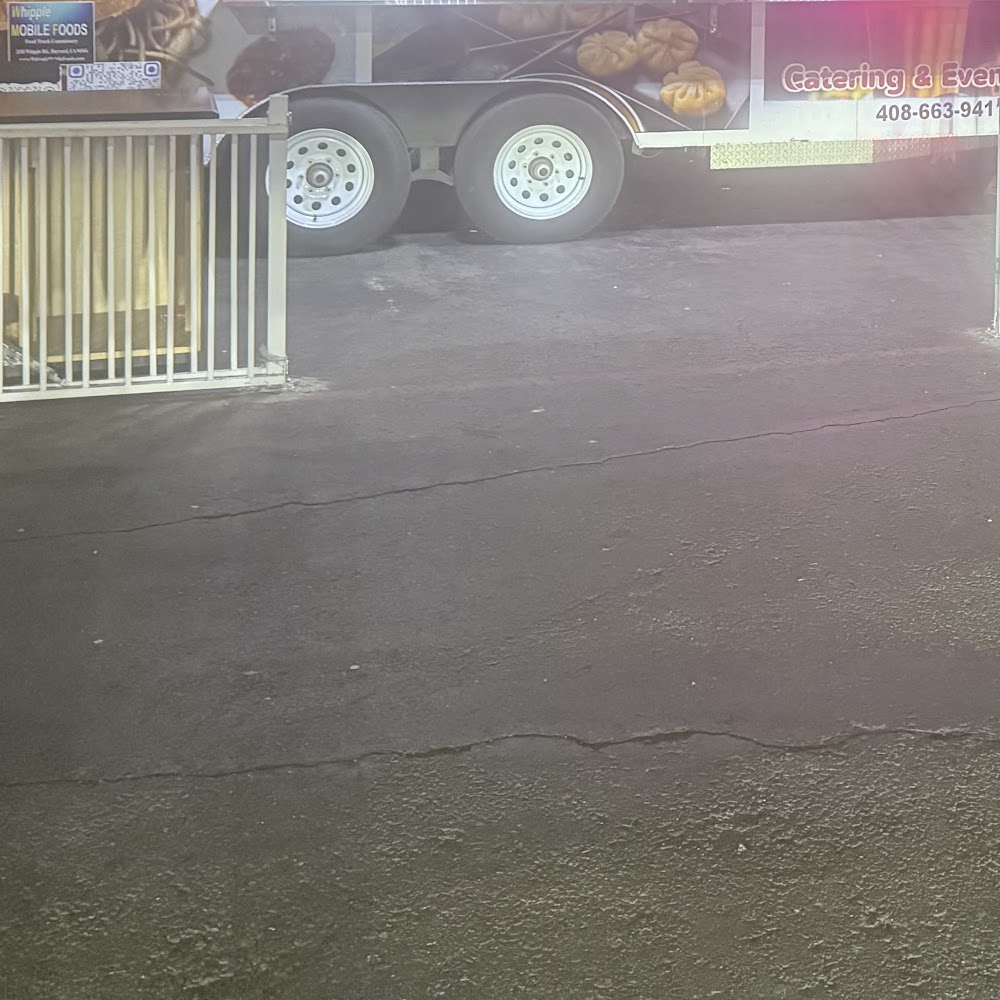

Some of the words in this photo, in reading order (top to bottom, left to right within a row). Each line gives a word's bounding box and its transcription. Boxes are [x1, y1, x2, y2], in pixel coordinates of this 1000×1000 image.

[11, 5, 51, 21] Whipple
[10, 24, 50, 37] MOBILE
[52, 23, 88, 36] FOODS
[781, 63, 906, 97] Catering
[911, 63, 934, 90] &
